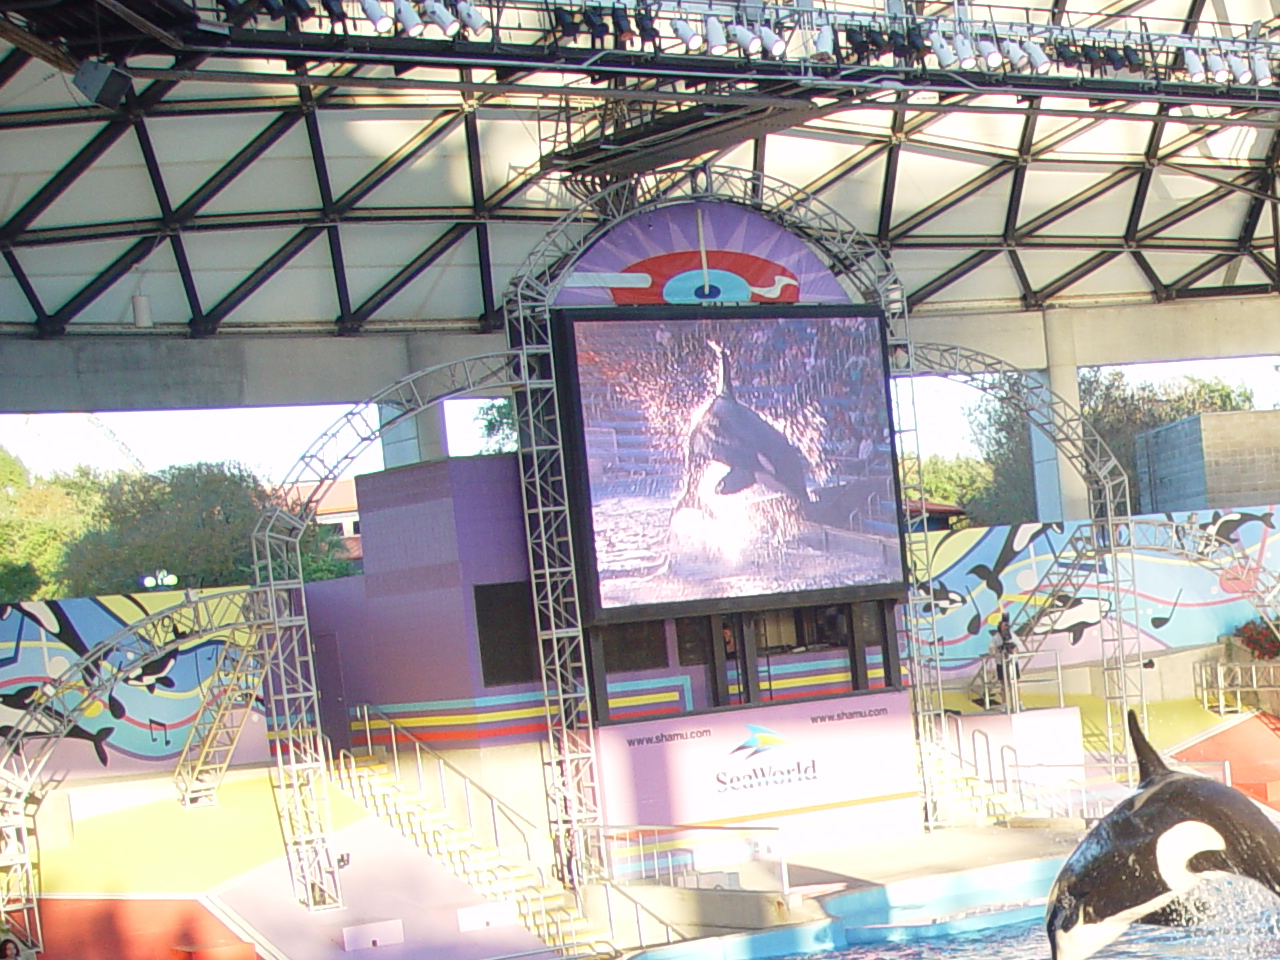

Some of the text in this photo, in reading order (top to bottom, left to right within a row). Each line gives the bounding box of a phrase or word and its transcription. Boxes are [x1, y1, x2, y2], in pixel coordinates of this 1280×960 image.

[810, 707, 889, 724] www.shamu.com
[626, 728, 712, 748] www.shamu.com
[716, 759, 818, 793] SeaWorld
